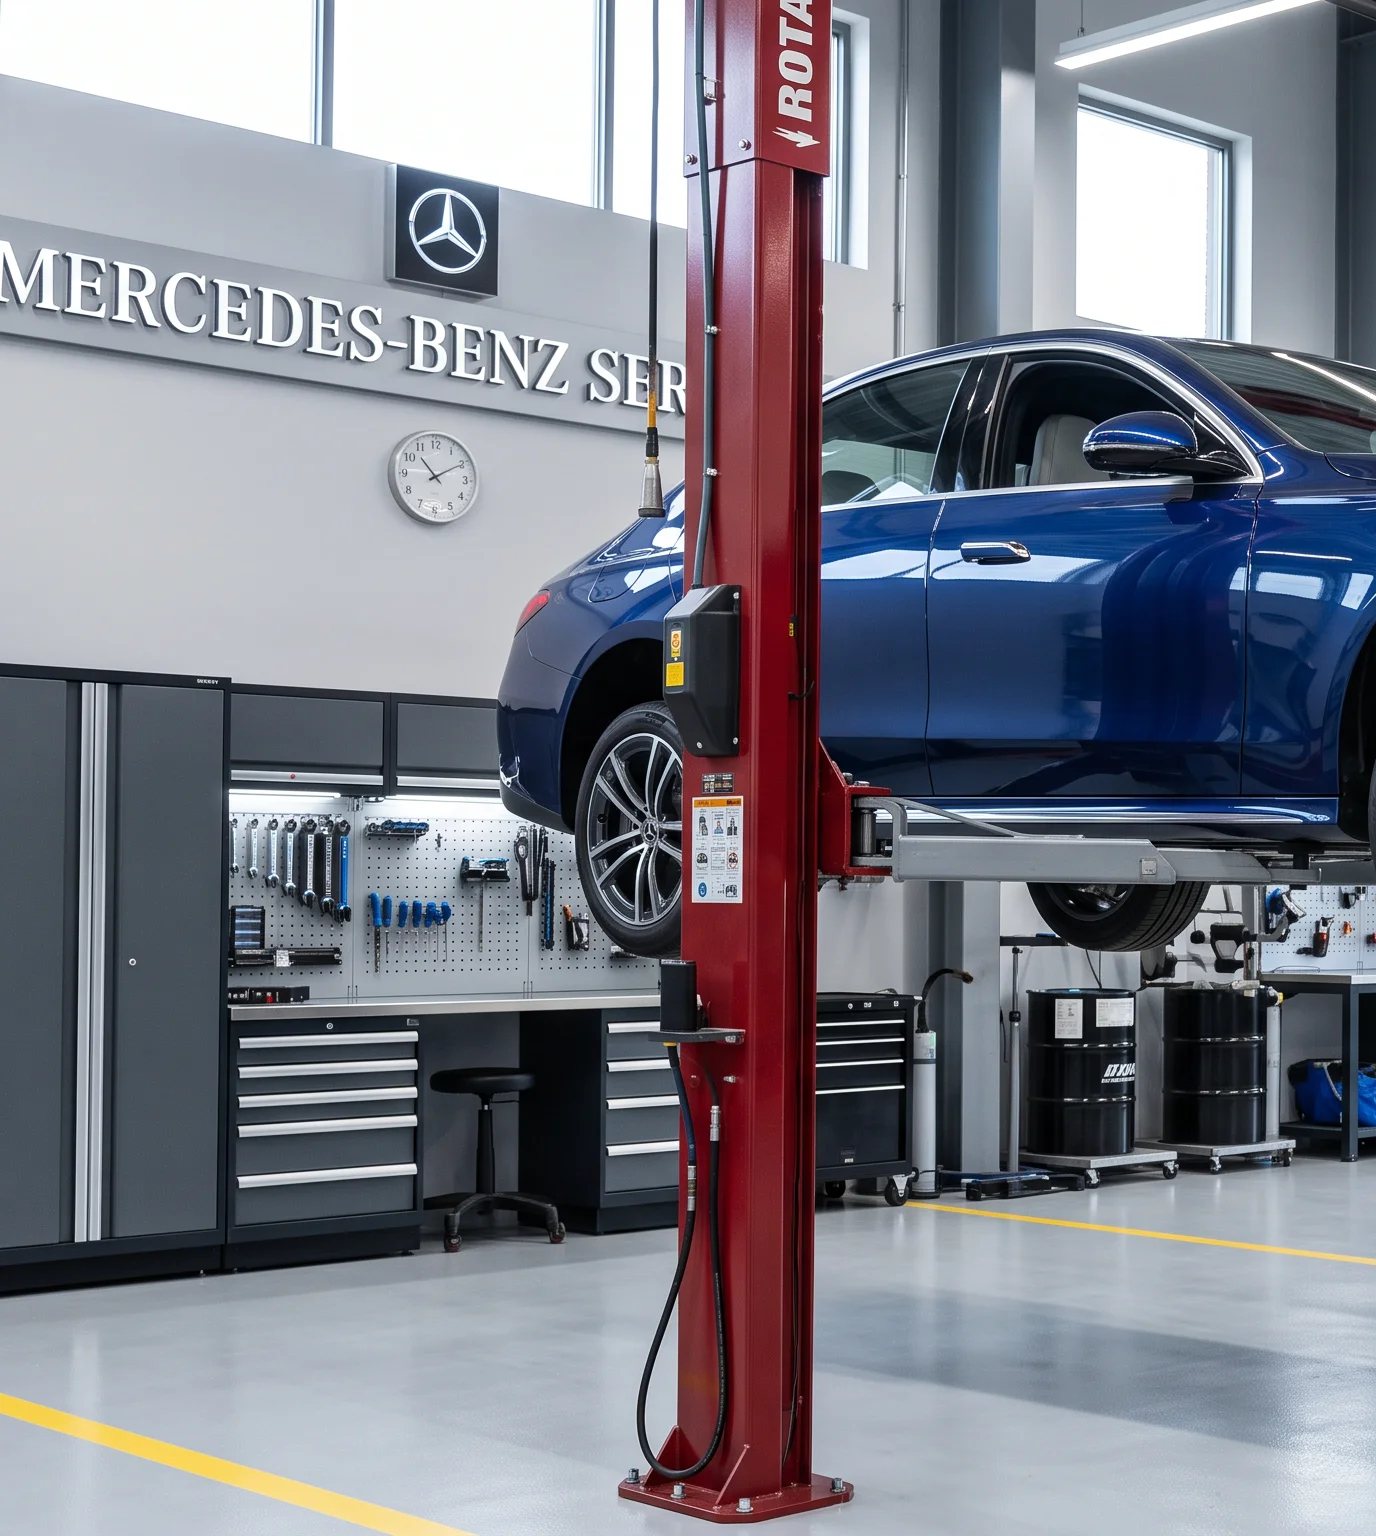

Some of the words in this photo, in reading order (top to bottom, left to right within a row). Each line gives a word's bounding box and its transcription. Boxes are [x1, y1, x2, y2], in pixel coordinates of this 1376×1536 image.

[0, 239, 569, 395] MERCEDES-BENZ
[415, 442, 424, 452] 11
[431, 440, 441, 450] 12
[404, 452, 416, 462] 10
[401, 468, 408, 477] 9
[462, 475, 468, 485] 3
[405, 485, 412, 494] 8
[457, 492, 464, 500] 4
[417, 498, 423, 508] 7
[447, 501, 453, 511] 5
